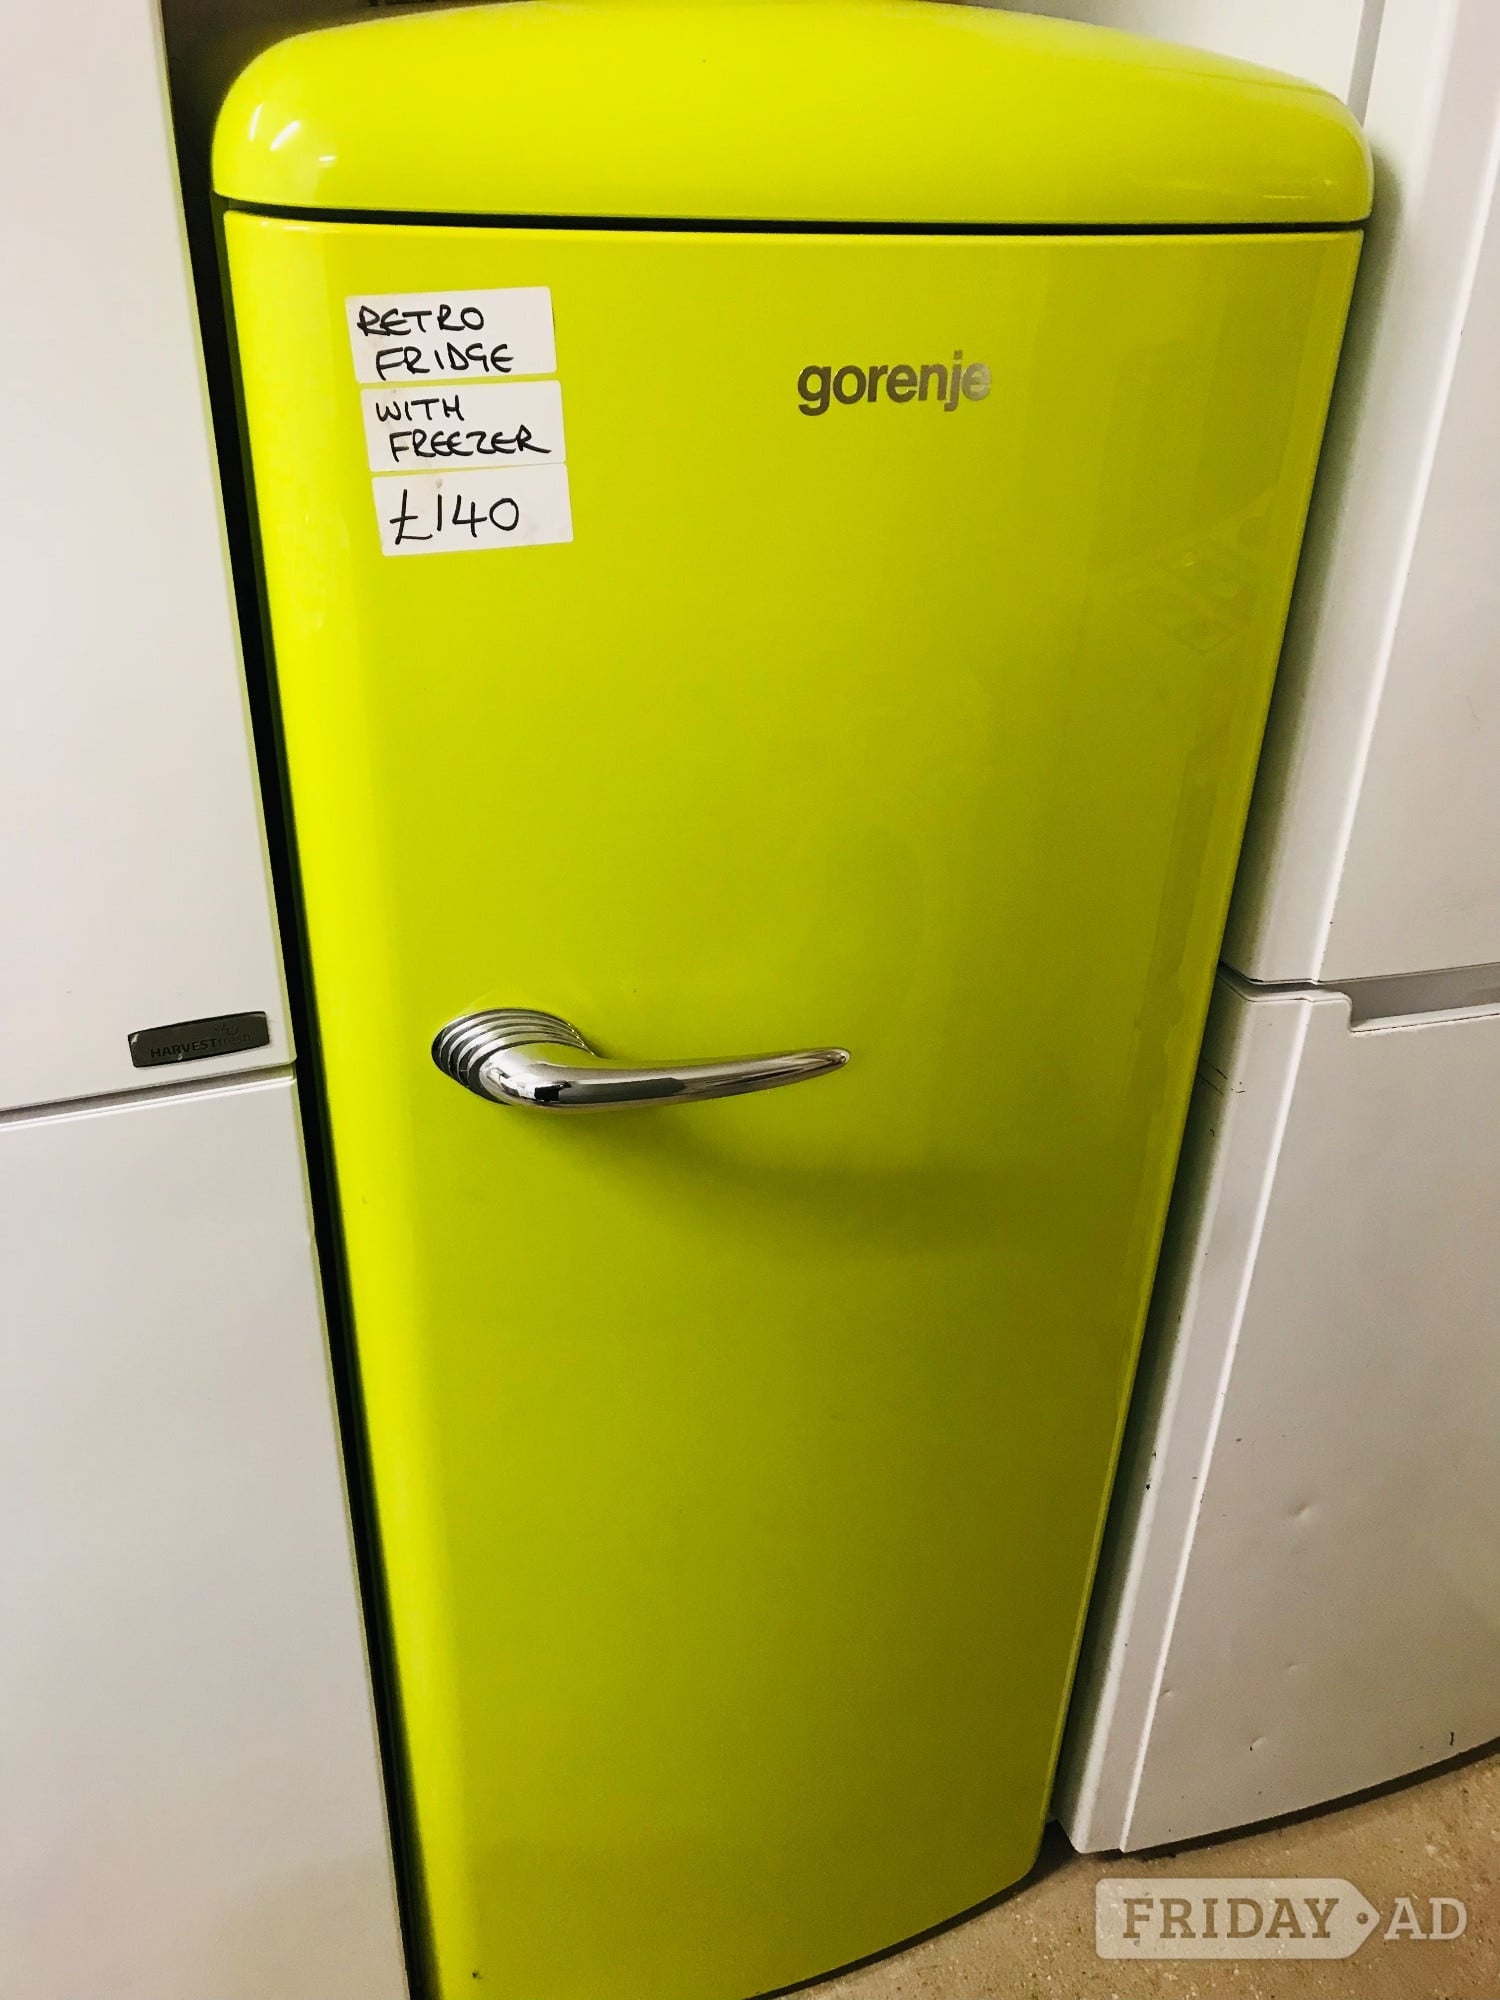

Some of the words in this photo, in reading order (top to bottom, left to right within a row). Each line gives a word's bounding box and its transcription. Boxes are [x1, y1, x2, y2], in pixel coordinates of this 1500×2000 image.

[357, 304, 484, 336] RETRO
[375, 342, 514, 380] FRIDGE
[797, 349, 992, 416] gorenje
[375, 394, 465, 421] WITH
[389, 424, 552, 462] FREEZER
[390, 489, 520, 544] £140
